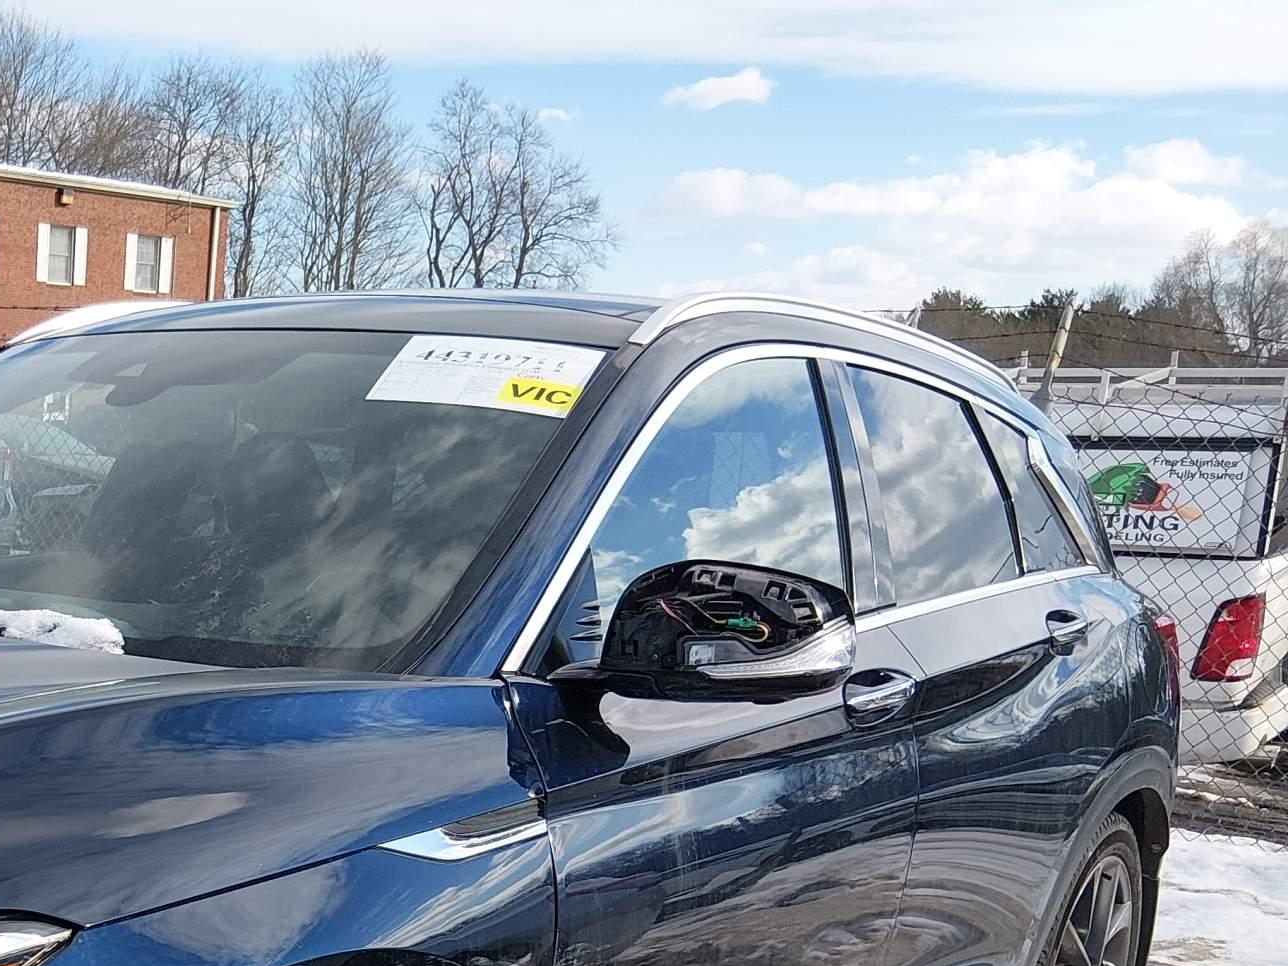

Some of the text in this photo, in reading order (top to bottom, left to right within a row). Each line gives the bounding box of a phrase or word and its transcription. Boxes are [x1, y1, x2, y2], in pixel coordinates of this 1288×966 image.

[511, 383, 573, 405] VIC
[1153, 456, 1238, 468] Free Estimates
[1169, 469, 1243, 481] Fully Insured
